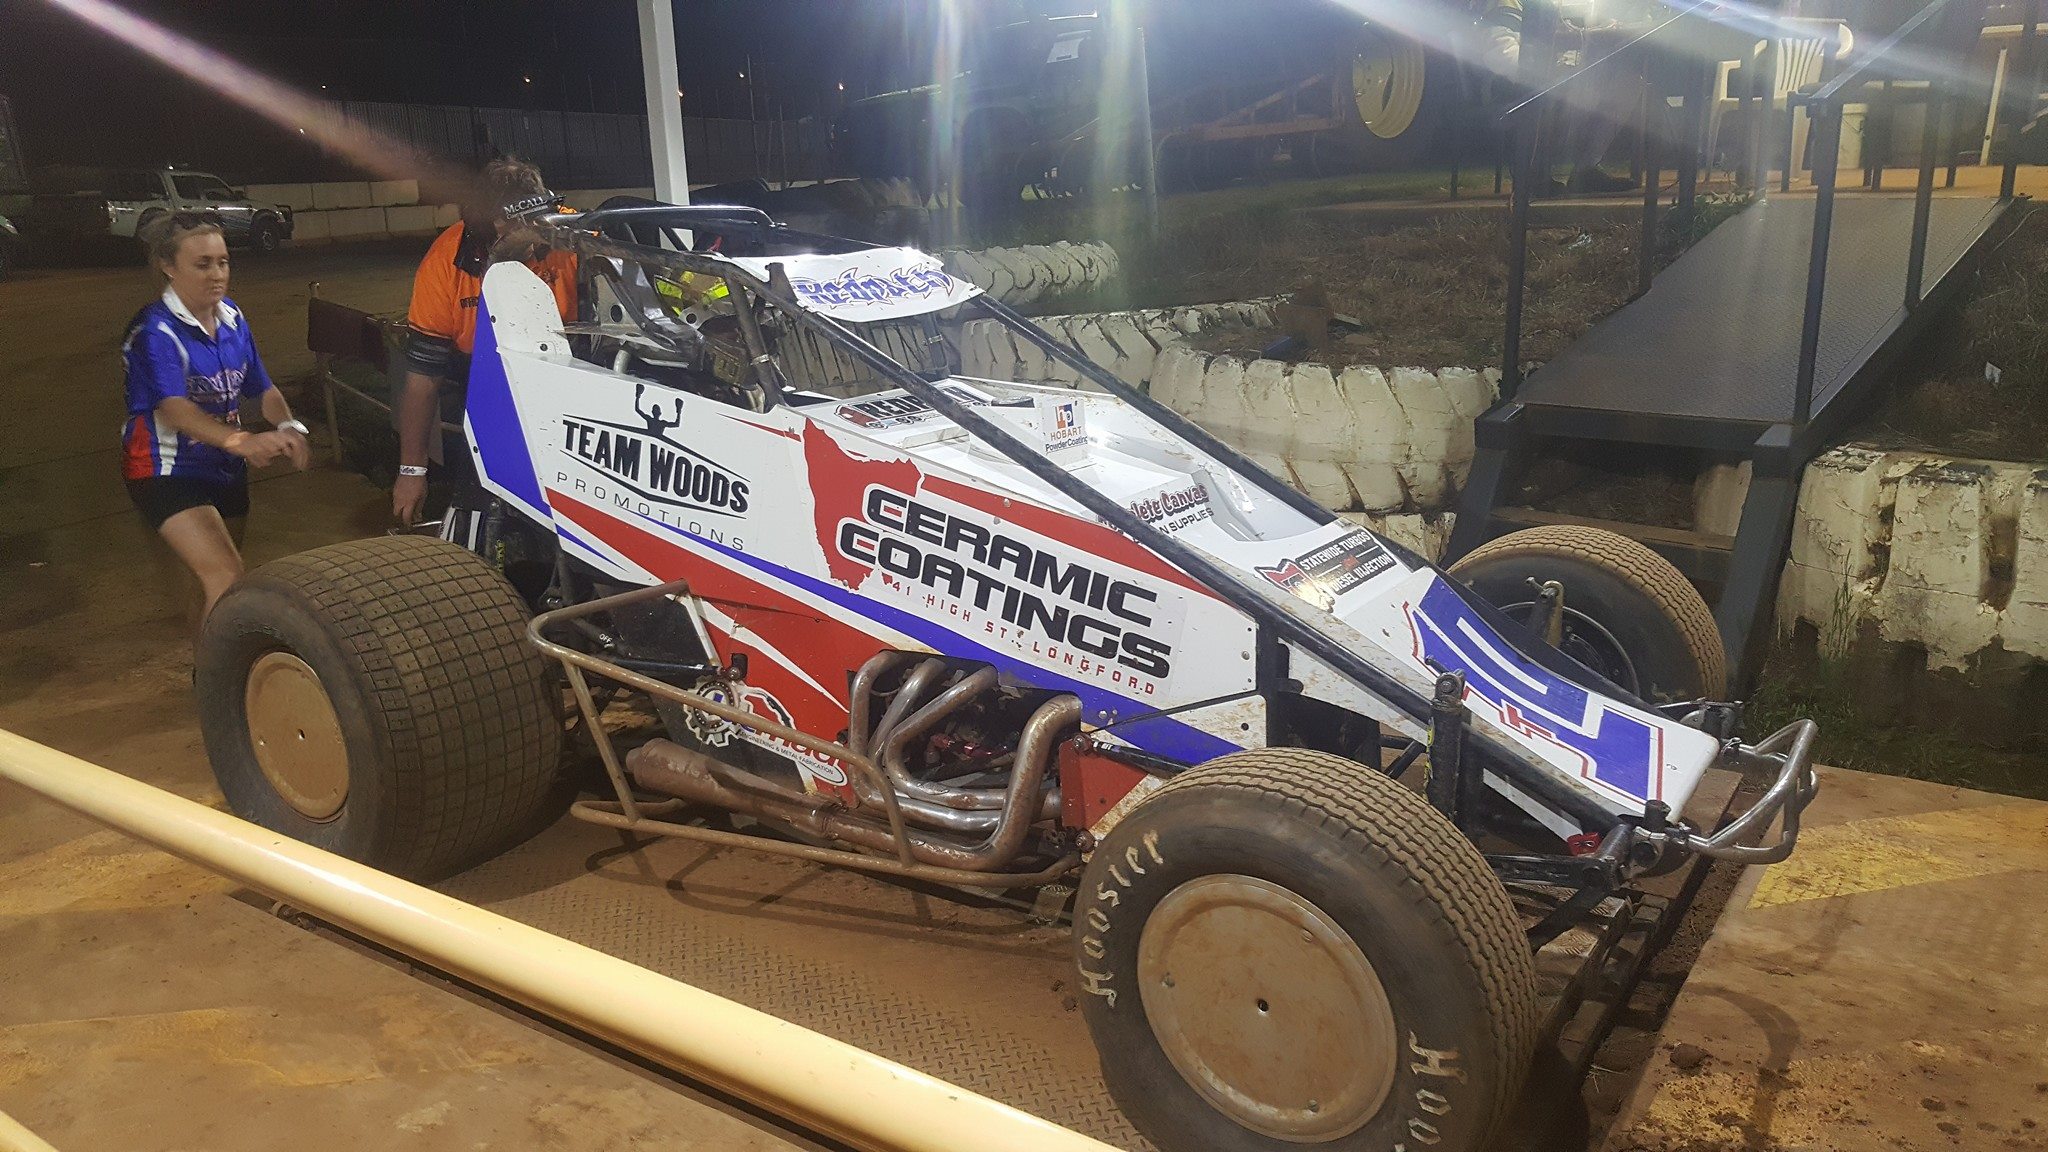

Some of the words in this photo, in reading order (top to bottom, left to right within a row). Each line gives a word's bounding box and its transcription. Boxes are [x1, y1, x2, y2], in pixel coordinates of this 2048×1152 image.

[563, 420, 642, 482] TEAM
[650, 443, 750, 513] WOODS
[1050, 426, 1082, 441] HOBART
[556, 472, 745, 551] PROMOTIONS
[1160, 483, 1209, 516] Canvas
[1169, 507, 1214, 532] SUPPLIES
[867, 488, 1158, 627] CERAMIC
[1299, 544, 1341, 571] STATEWIDE
[1341, 531, 1371, 554] TURBOS
[1353, 553, 1394, 579] INJECTION
[840, 522, 1172, 679] COATINGS
[893, 581, 911, 596] 41
[927, 593, 971, 622] HIGH
[1032, 641, 1155, 695] LONGFORD
[1078, 829, 1166, 1009] Hoosier
[1393, 1029, 1468, 1152] Hoo
